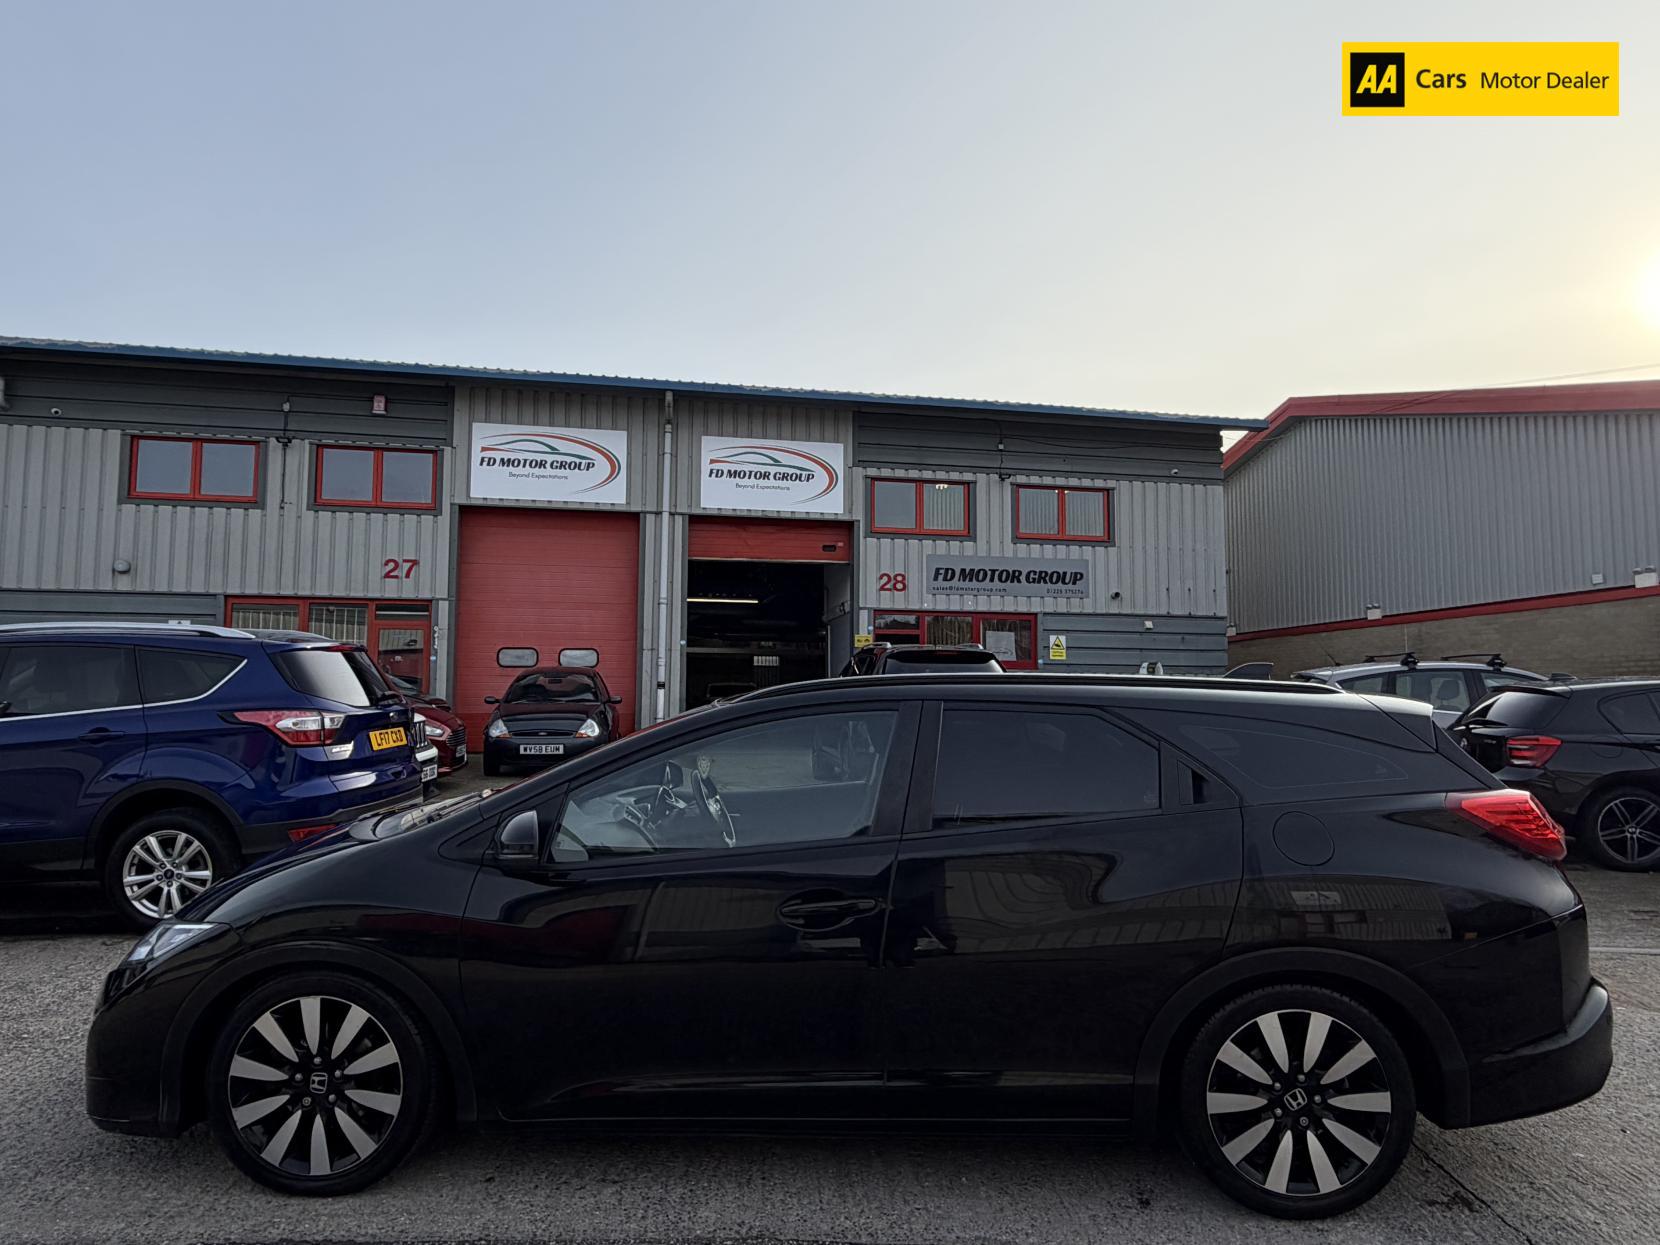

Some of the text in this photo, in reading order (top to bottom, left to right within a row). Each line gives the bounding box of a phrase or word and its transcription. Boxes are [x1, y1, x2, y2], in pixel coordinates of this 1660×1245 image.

[479, 456, 596, 472] FD MOTOR GROUP
[508, 471, 569, 481] Beyond Expectations
[708, 468, 815, 483] FD MOTOR GROUP
[735, 482, 755, 490] Beyond
[383, 558, 418, 579] 27
[932, 567, 1084, 586] FD MOTOR GROUP
[879, 572, 907, 592] 28
